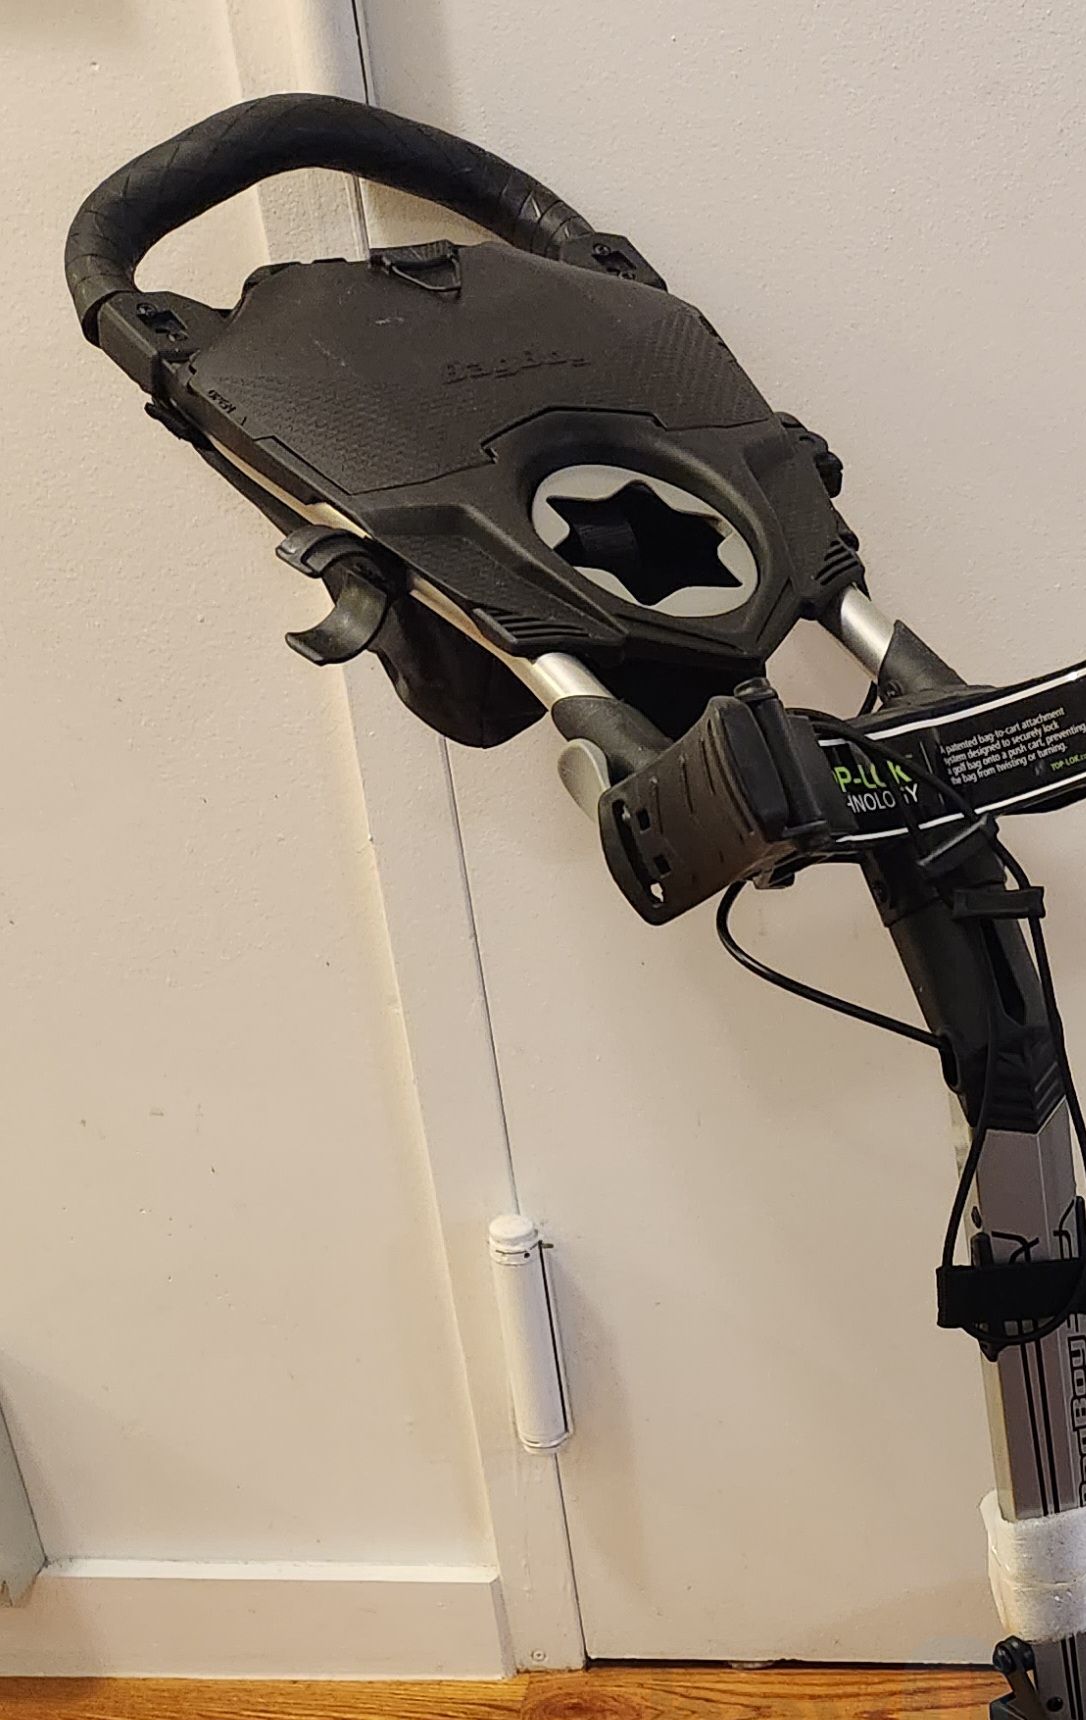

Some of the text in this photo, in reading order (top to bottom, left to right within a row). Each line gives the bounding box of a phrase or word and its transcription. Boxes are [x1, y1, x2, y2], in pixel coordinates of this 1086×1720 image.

[945, 735, 979, 756] patented
[977, 722, 1021, 744] bag-to-cart
[1021, 707, 1065, 730] attachment
[967, 740, 1002, 759] designed
[1001, 738, 1011, 748] to
[1011, 727, 1043, 745] securely
[1041, 720, 1060, 733] lock
[950, 742, 1068, 785] the bag from twisting or turning.
[952, 761, 967, 776] golf
[965, 760, 983, 771] bag
[982, 753, 1001, 766] onto
[1001, 751, 1008, 760] a
[1008, 743, 1028, 760] push
[1027, 738, 1046, 751] cart,
